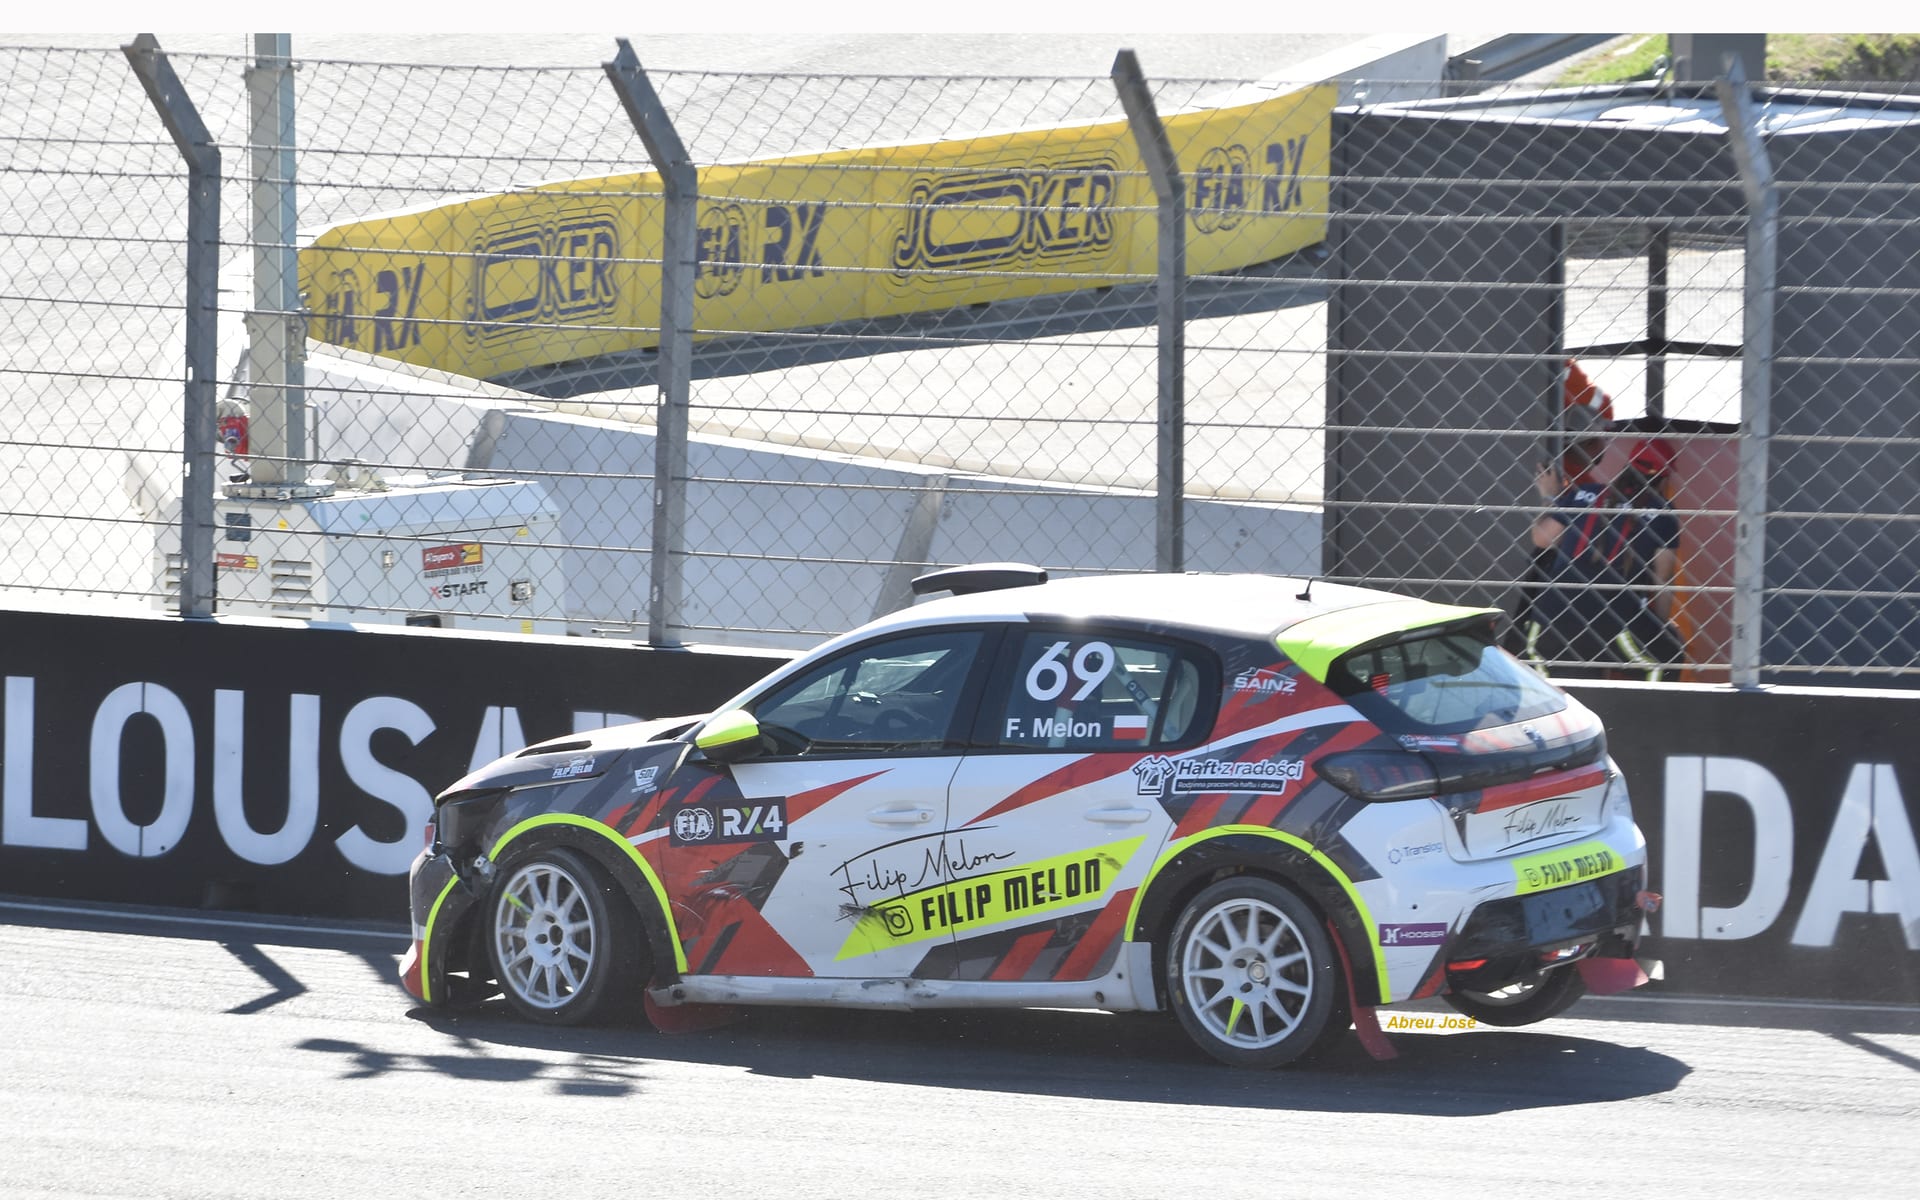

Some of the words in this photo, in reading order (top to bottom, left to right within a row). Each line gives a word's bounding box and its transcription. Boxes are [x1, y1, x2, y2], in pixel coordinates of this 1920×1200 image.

[1262, 134, 1308, 217] RX
[761, 200, 826, 285] RX
[895, 168, 1115, 267] JOKER
[373, 262, 425, 354] RX
[465, 225, 618, 333] JOKER
[1026, 641, 1115, 701] 69
[1234, 676, 1297, 692] SAINZ
[1006, 718, 1025, 738] F.
[1032, 718, 1101, 738] Melon
[1178, 760, 1218, 775] Haft
[1235, 759, 1302, 777] radości
[722, 805, 783, 836] RX4
[832, 860, 907, 906] Filip
[910, 838, 1016, 888] Melon
[922, 883, 992, 931] FILIP
[1003, 857, 1101, 912] MELON
[1541, 861, 1572, 885] FILIP
